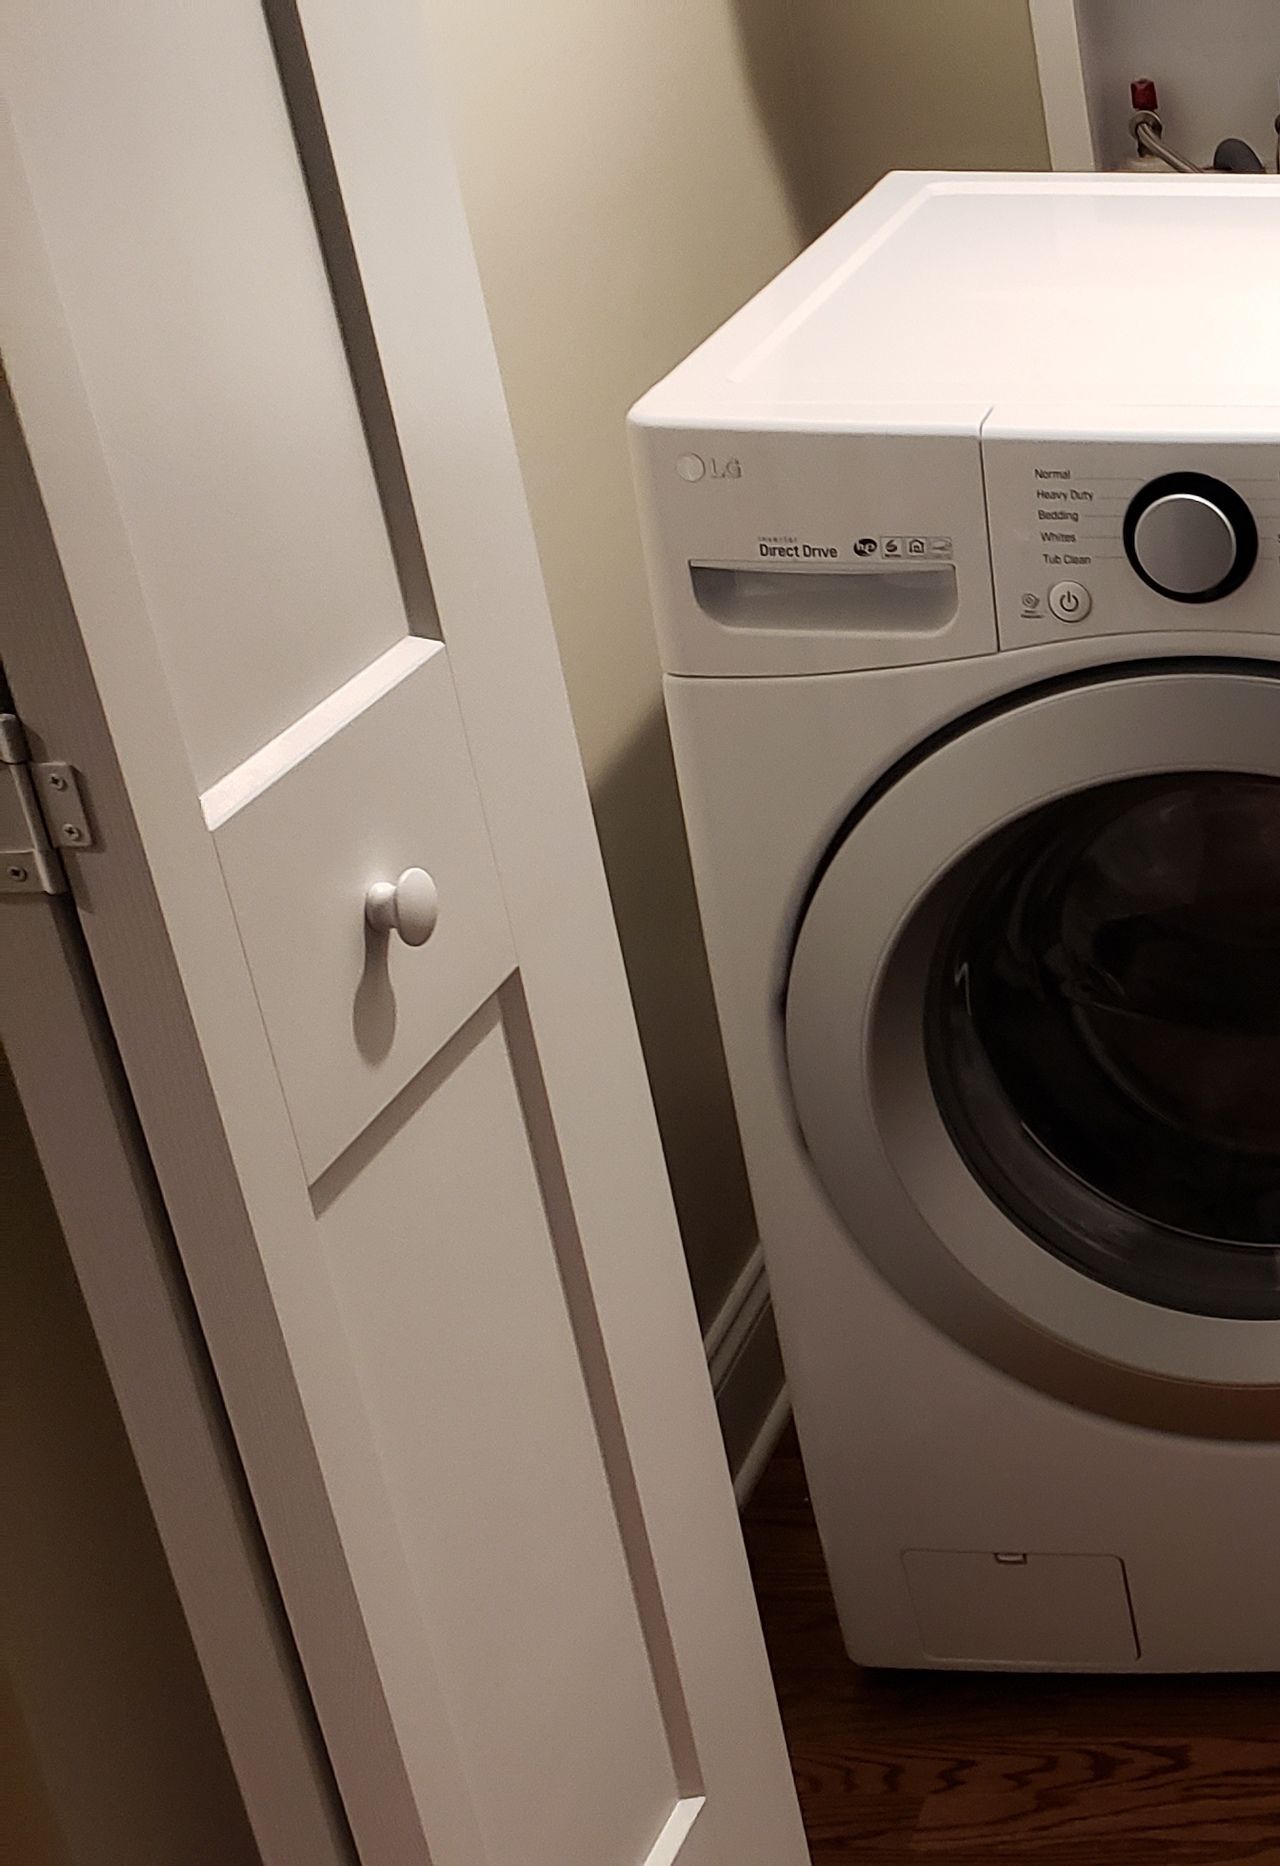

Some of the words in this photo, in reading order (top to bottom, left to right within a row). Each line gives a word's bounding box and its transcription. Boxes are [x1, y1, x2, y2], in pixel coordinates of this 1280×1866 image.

[1034, 468, 1071, 480] Normal
[1037, 489, 1067, 501] Heavy
[1070, 488, 1093, 502] Duty
[1038, 509, 1079, 522] Bedding
[1040, 532, 1076, 543] Whites
[759, 543, 800, 558] Direct
[802, 544, 838, 559] Drive
[1042, 553, 1062, 564] Tub
[1063, 554, 1092, 565] Clean
